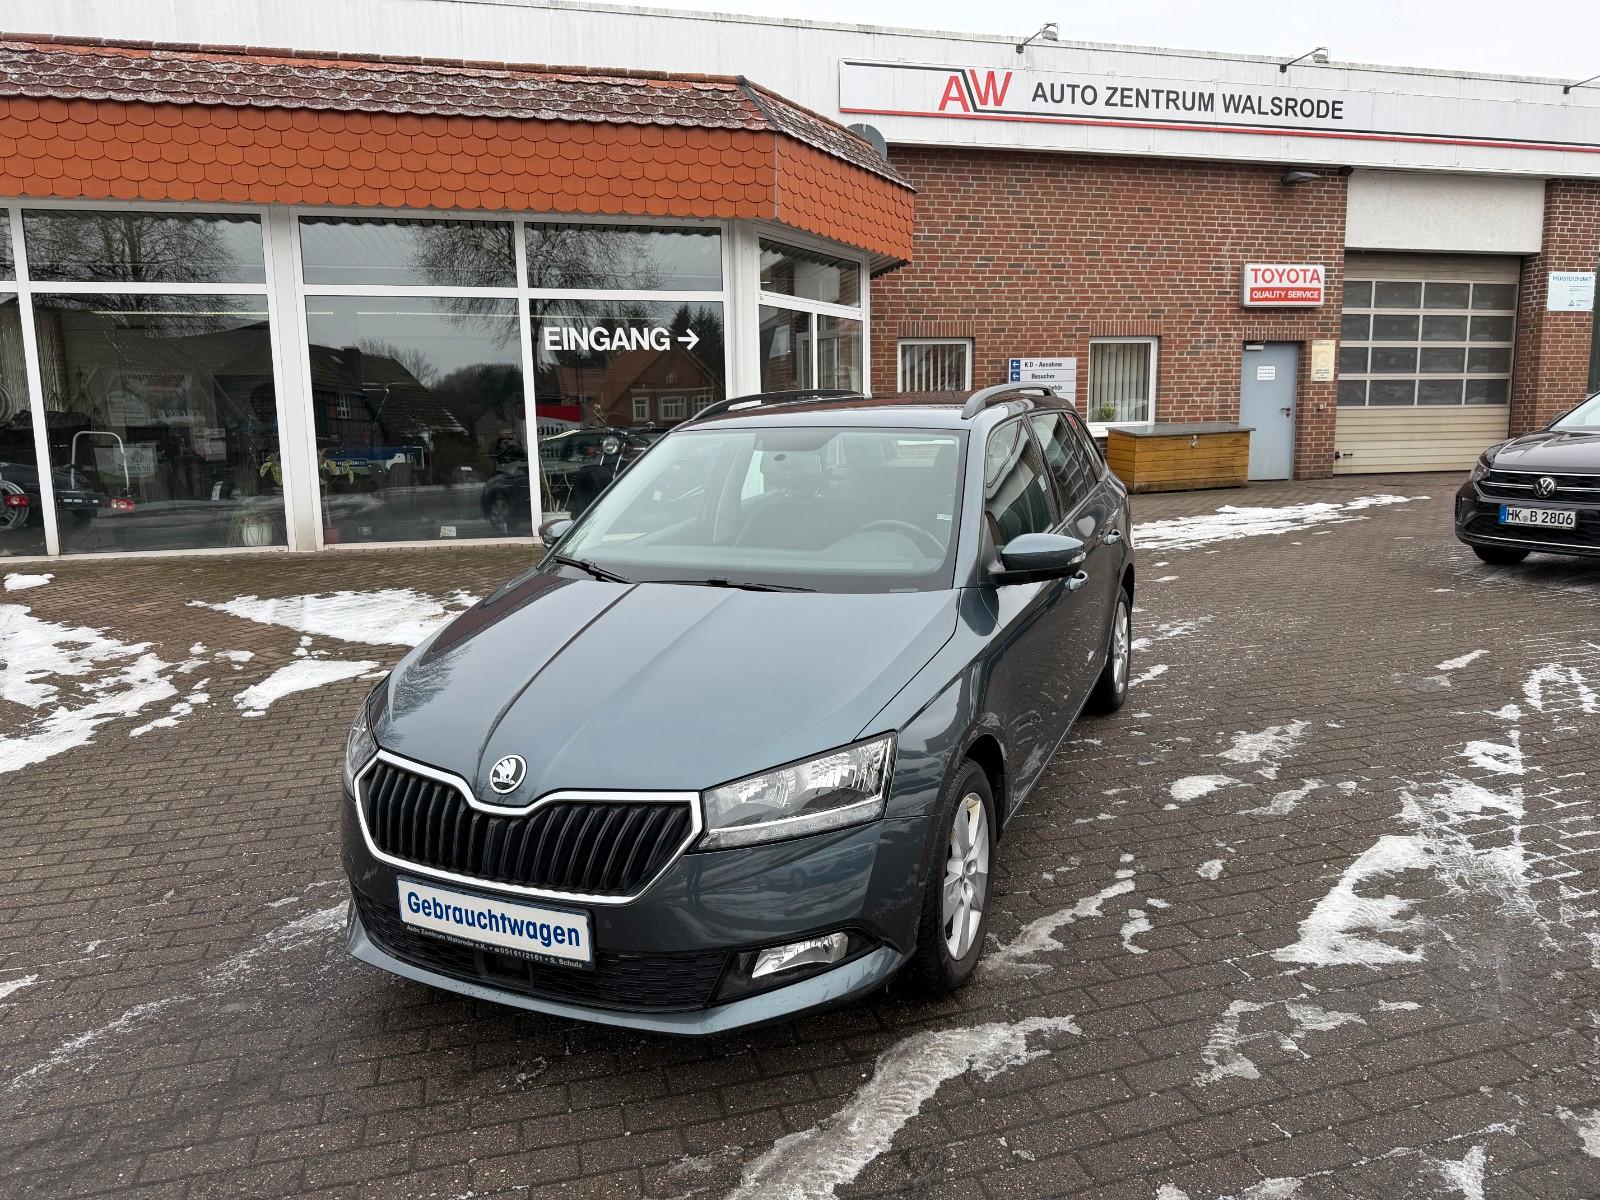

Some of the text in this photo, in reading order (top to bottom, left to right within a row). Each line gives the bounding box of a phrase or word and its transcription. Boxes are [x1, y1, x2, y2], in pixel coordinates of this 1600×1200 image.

[1031, 82, 1098, 106] AUTO
[1105, 86, 1215, 112] ZENTRUM
[1222, 93, 1344, 119] WALSRODE
[1250, 268, 1321, 284] TOYOTA
[1252, 290, 1319, 299] QUALITY SERVICE
[543, 326, 671, 351] EINGANG
[1031, 372, 1056, 380] Besucher
[1506, 508, 1574, 526] HK B 2806
[407, 891, 580, 947] Gebrauchtwagen
[406, 924, 420, 934] Auto
[420, 929, 446, 940] Zentrum
[446, 935, 474, 947] Walsrode
